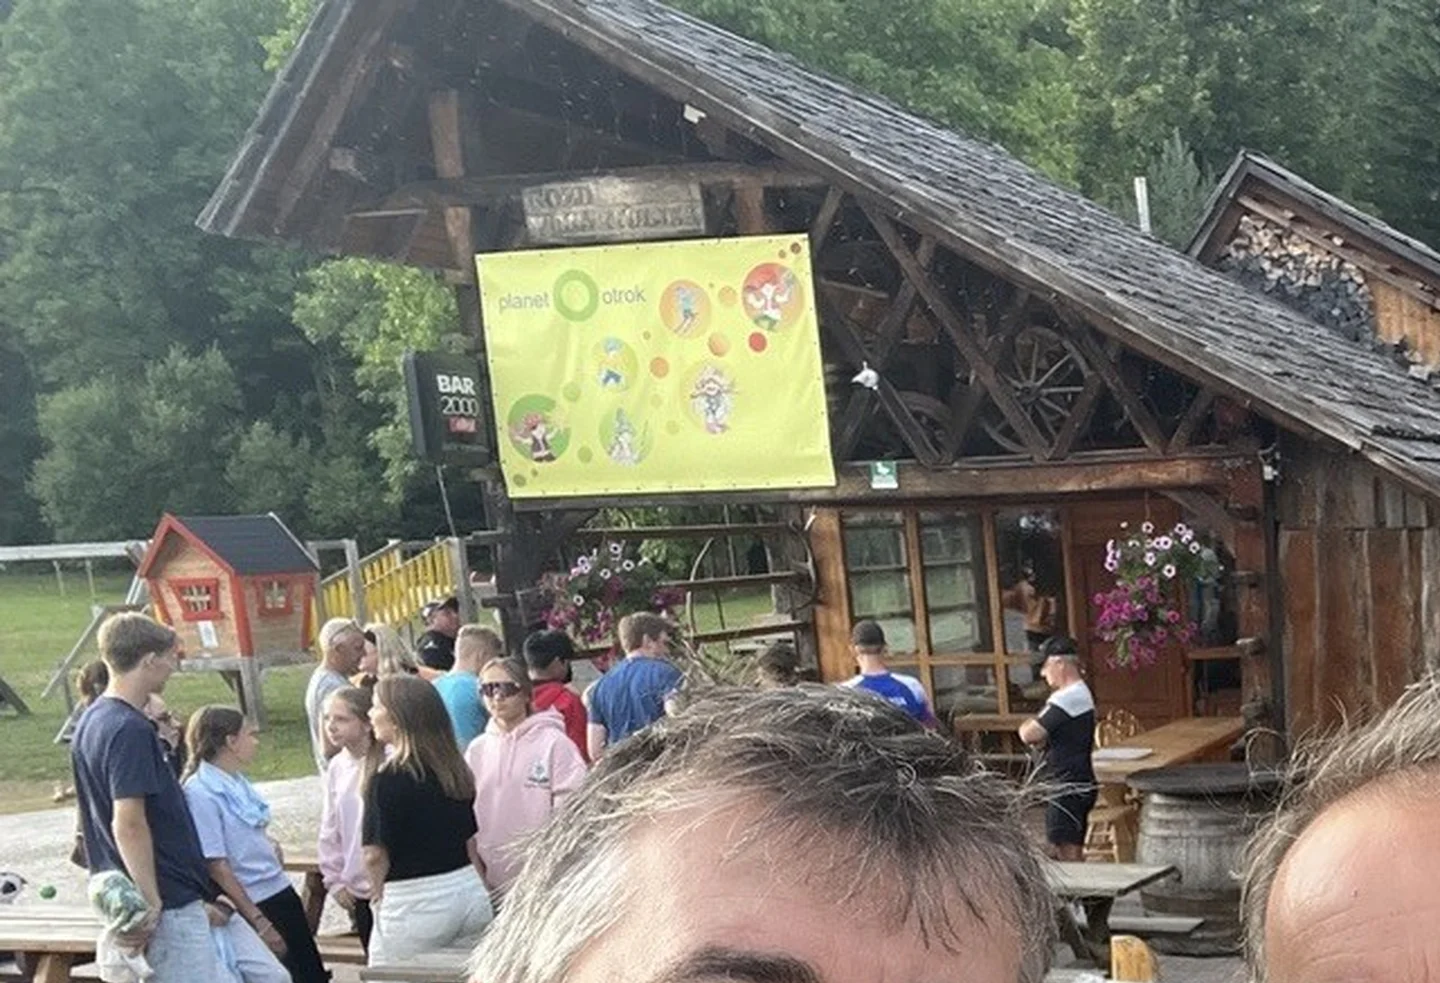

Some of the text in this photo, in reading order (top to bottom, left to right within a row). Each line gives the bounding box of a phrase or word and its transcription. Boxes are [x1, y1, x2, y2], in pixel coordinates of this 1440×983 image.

[499, 284, 647, 314] planet otrok
[436, 374, 476, 395] BAR
[441, 396, 480, 417] 2000
